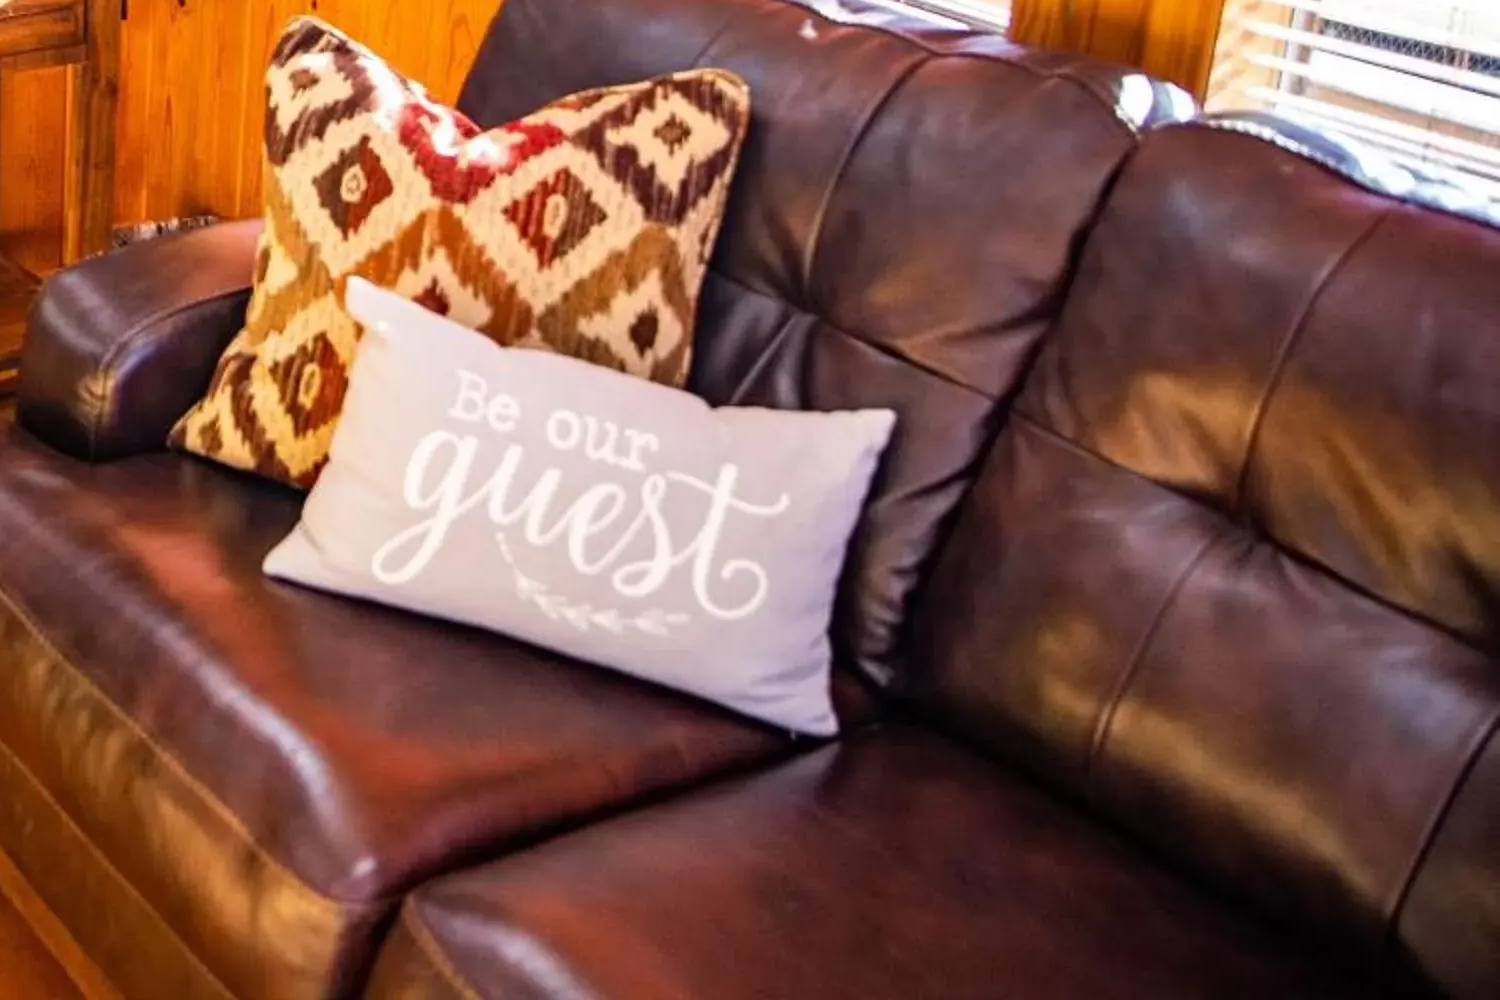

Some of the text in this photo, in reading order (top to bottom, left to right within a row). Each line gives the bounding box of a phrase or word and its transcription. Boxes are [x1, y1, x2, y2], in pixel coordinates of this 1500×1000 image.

[447, 368, 660, 472] Be our
[371, 429, 791, 620] guest
